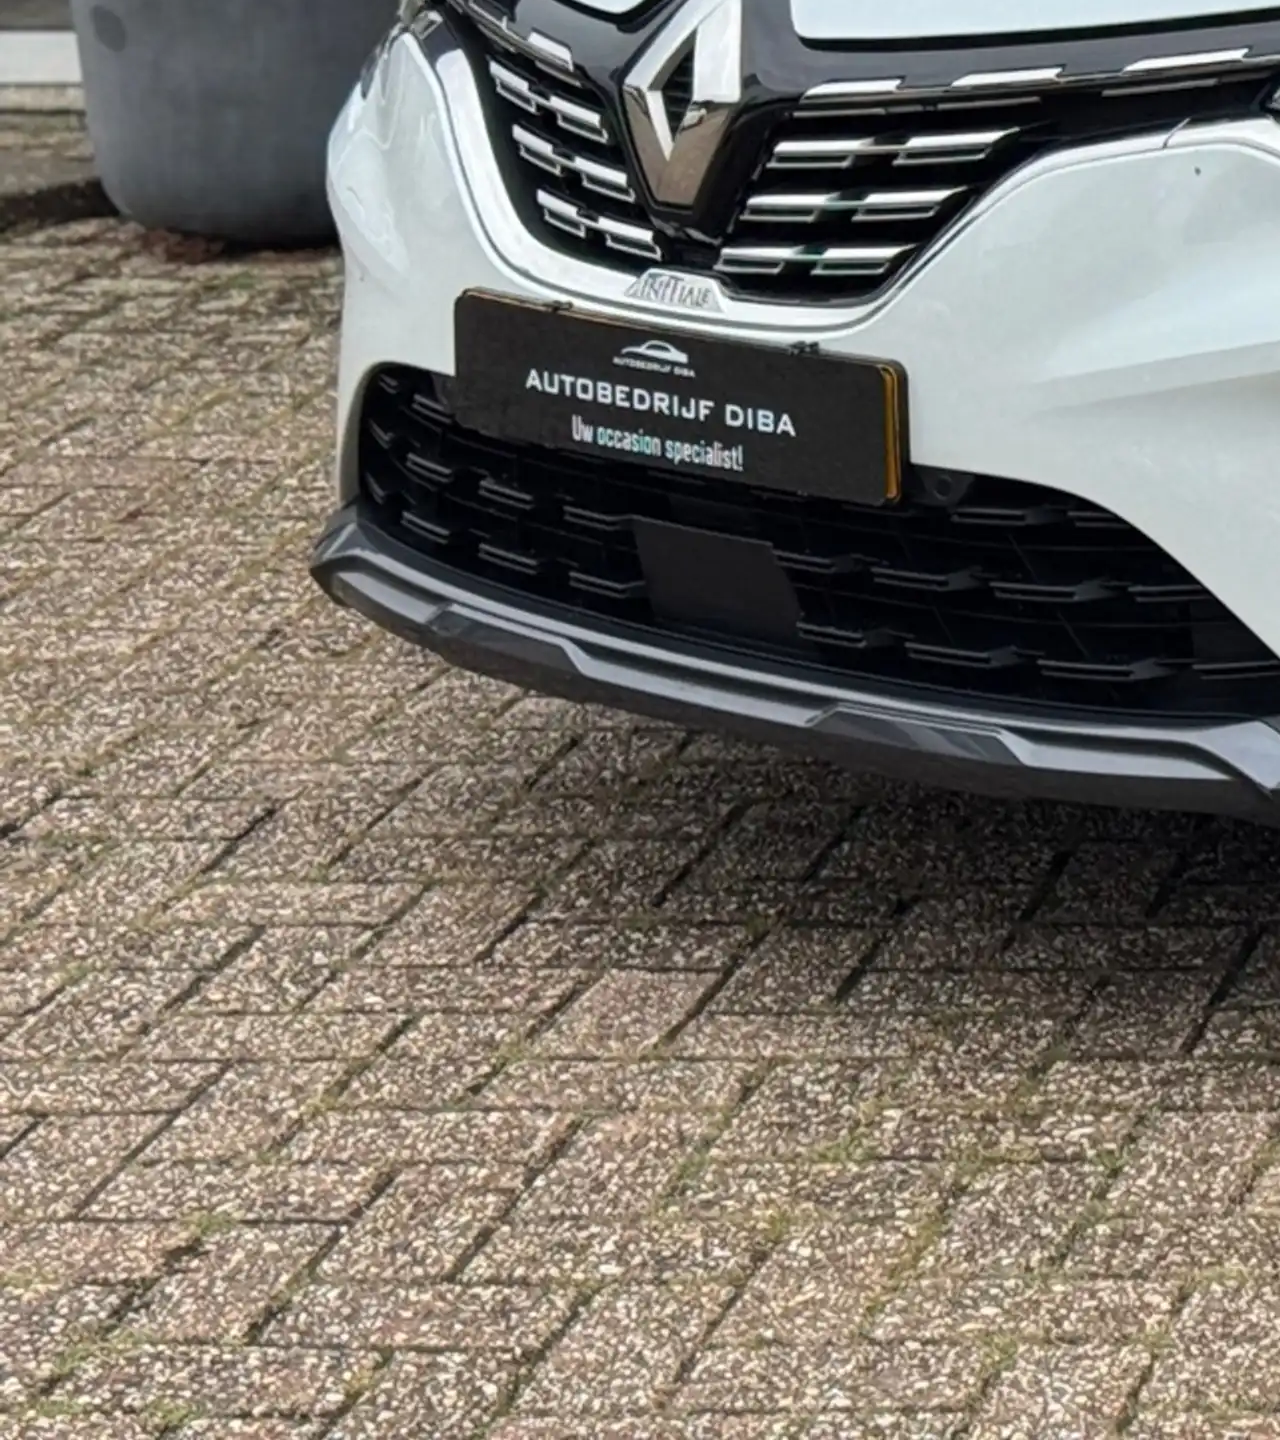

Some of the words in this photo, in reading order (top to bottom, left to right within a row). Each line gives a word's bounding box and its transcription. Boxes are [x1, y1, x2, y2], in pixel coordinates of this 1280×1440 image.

[525, 369, 716, 424] AUTOBEDRIJF
[725, 403, 797, 437] DIBA
[571, 415, 594, 444] Uw
[596, 426, 662, 458] occasion
[665, 437, 744, 472] specialist!
